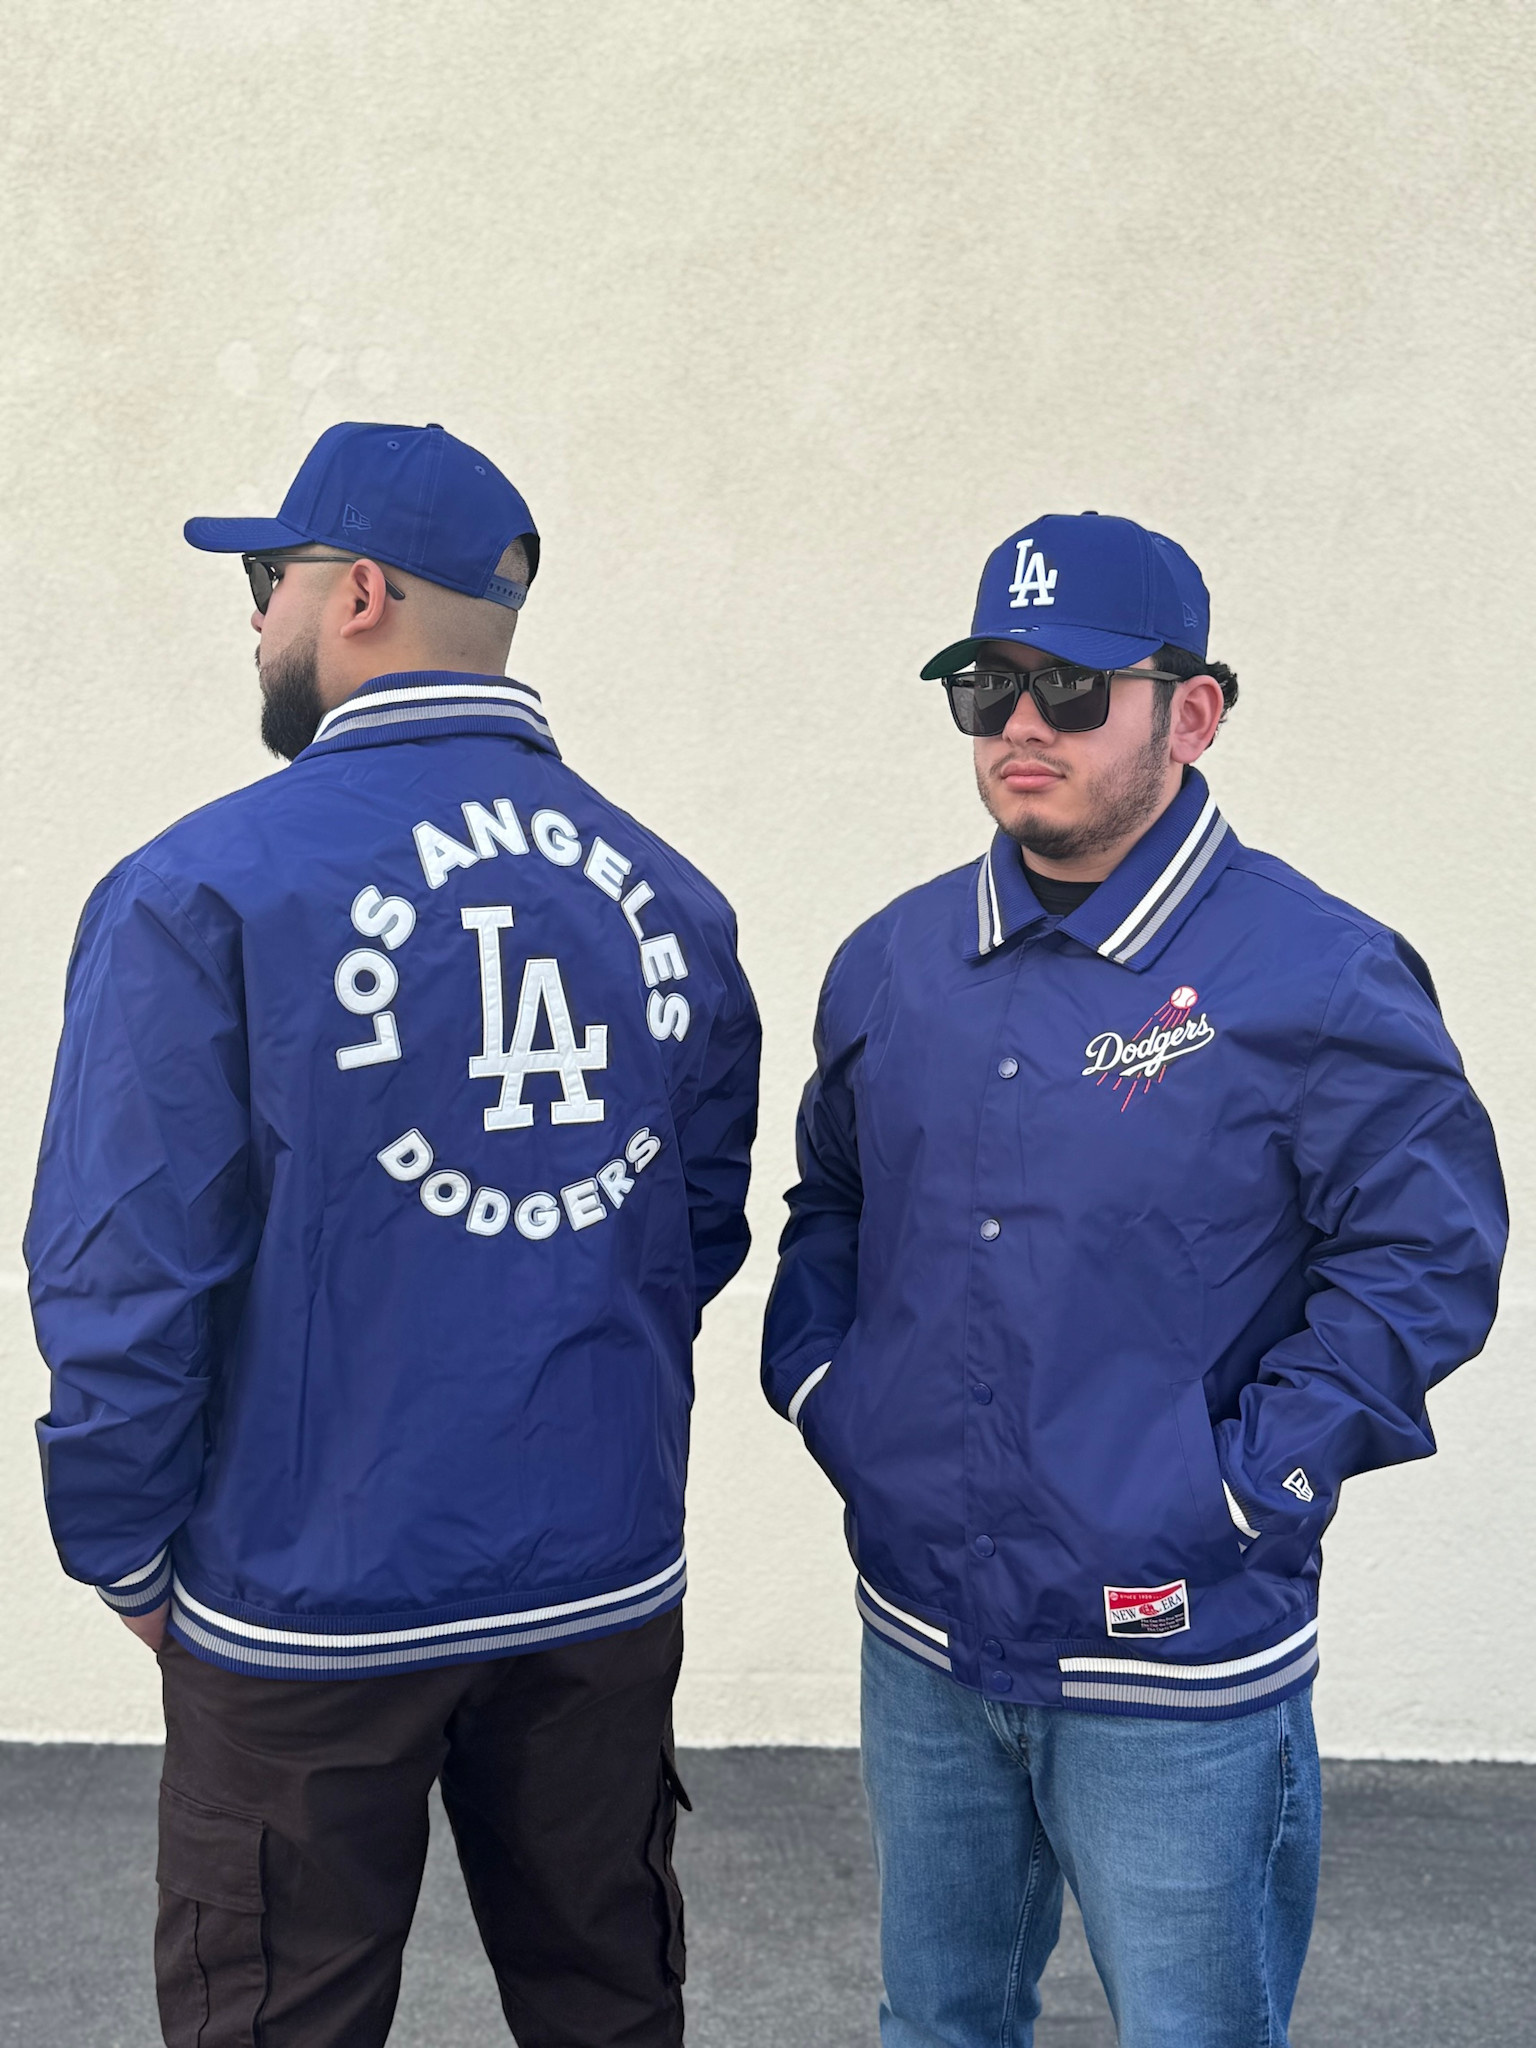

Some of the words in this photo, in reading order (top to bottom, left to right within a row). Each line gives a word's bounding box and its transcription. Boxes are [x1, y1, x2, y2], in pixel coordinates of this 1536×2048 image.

[1009, 538, 1058, 608] LA
[334, 885, 417, 1071] LOS
[411, 798, 691, 1042] ANGELES
[460, 905, 608, 1131] LA
[1081, 1012, 1215, 1077] Dodgers
[376, 1127, 661, 1240] DODGERS
[1111, 1607, 1137, 1622] NEW
[1161, 1592, 1182, 1610] ERA
